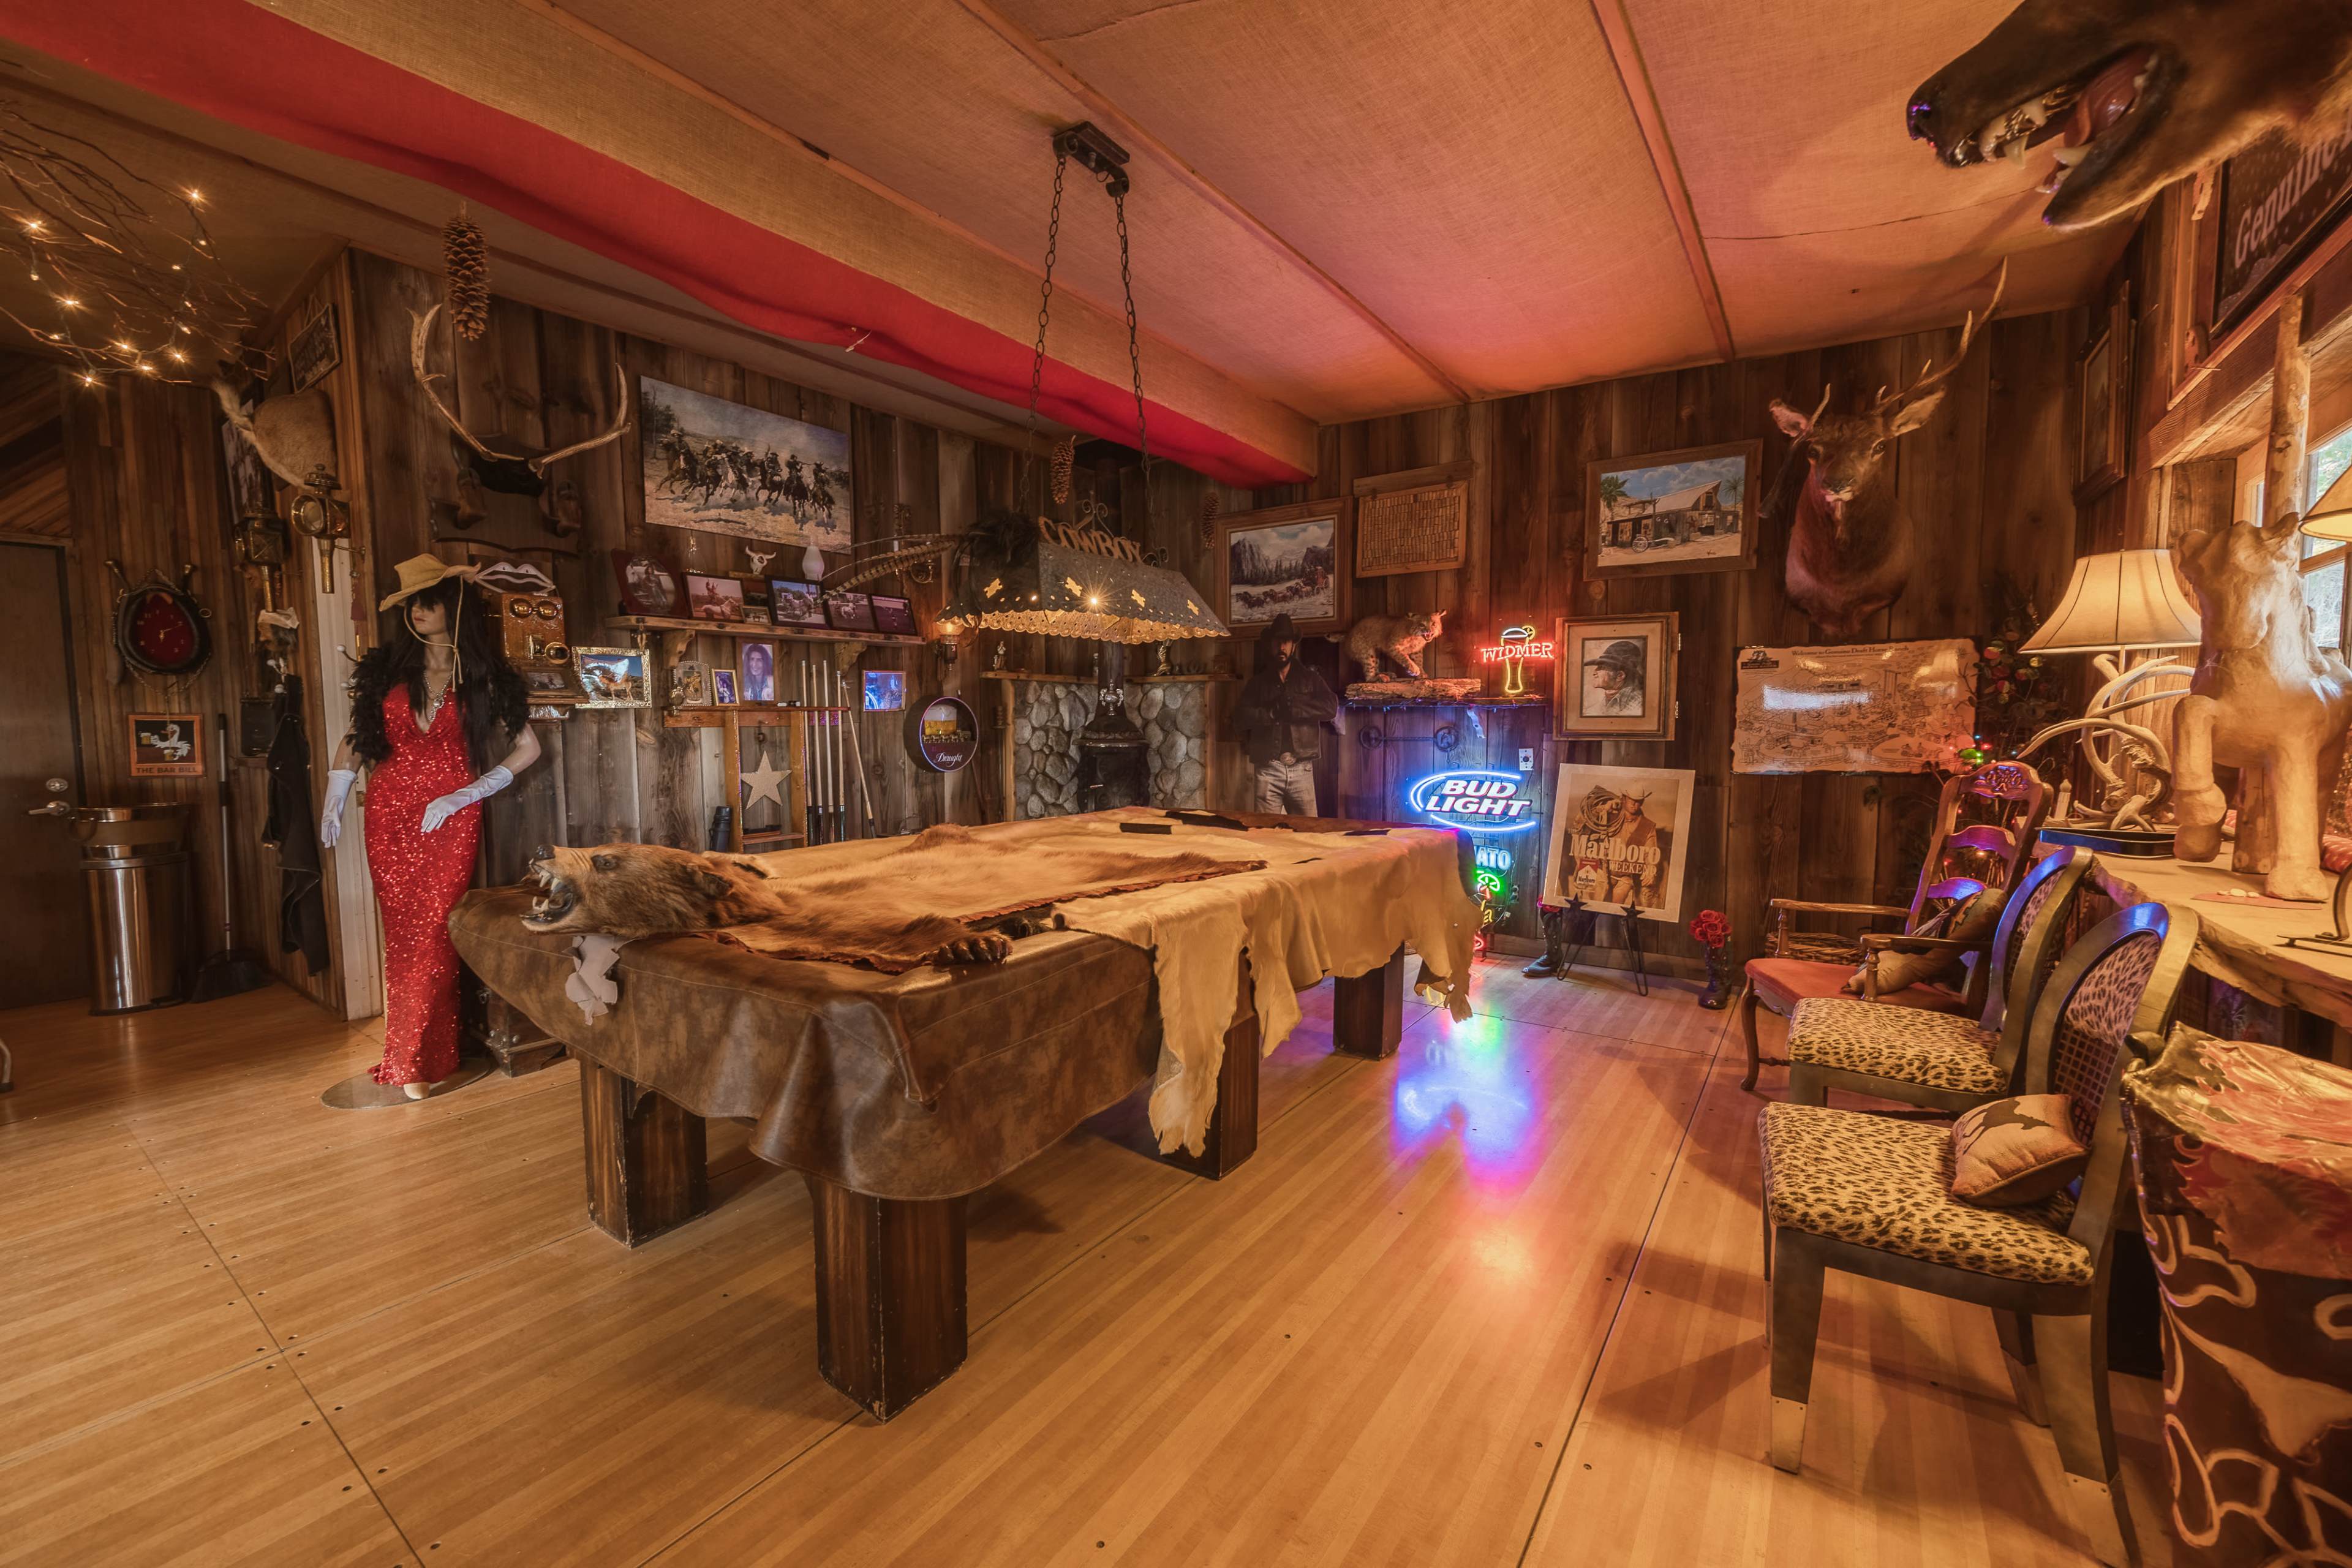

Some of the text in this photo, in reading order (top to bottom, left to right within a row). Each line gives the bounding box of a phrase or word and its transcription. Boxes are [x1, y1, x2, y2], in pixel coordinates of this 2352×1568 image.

[1038, 516, 1142, 564] COWBOY
[1480, 643, 1555, 663] WIDMER
[935, 752, 963, 767] Draught
[1441, 779, 1518, 799] BUD
[1425, 796, 1531, 817] LIGHT
[1568, 834, 1661, 865] Marlboro
[1608, 860, 1657, 876] WEEKEND
